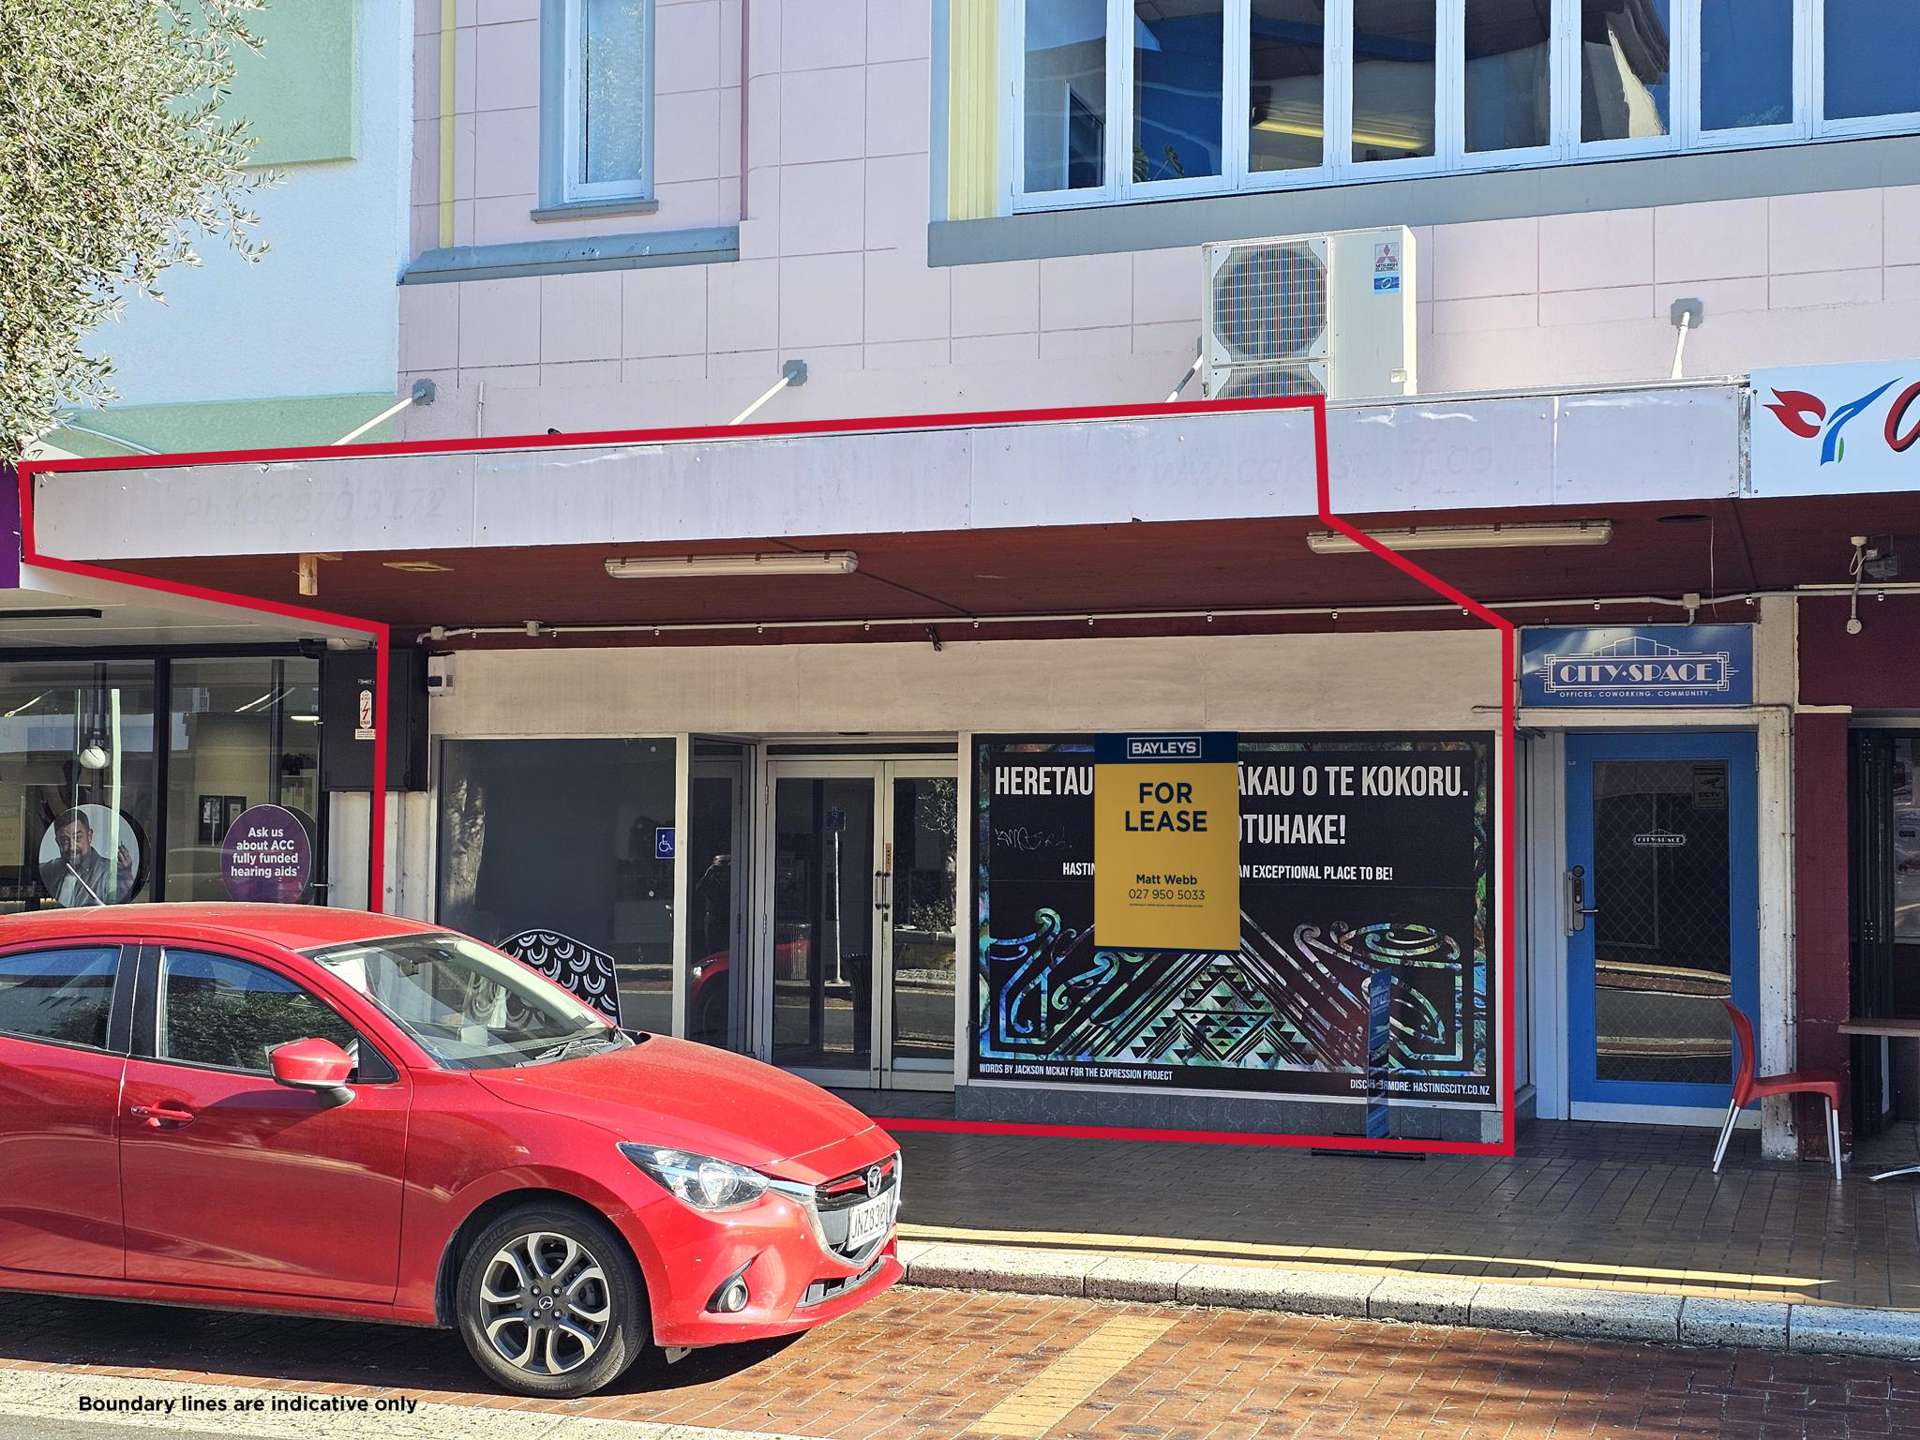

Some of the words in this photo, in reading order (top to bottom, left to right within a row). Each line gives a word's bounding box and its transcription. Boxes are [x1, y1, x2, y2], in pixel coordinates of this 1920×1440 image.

[1560, 664, 1624, 683] CITY
[1628, 663, 1713, 682] SPACE
[1132, 742, 1197, 754] BAYLEYS
[1302, 766, 1318, 796] O
[1324, 766, 1354, 796] TE
[1362, 765, 1469, 797] KOKORU.
[1139, 782, 1193, 804] FOR
[1125, 810, 1208, 832] LEASE
[248, 827, 269, 838] Ask
[271, 829, 284, 837] us
[236, 840, 268, 850] about
[271, 840, 295, 850] ACC
[232, 853, 257, 865] fully
[259, 853, 299, 863] funded
[230, 866, 272, 878] hearing
[1252, 865, 1322, 880] EXCEPTIONAL
[1324, 866, 1358, 880] PLACE
[1359, 866, 1373, 880] TO
[1375, 867, 1393, 880] BE!
[1136, 874, 1161, 885] Matt
[1164, 874, 1198, 885] Webb
[1128, 889, 1149, 899] 027
[1152, 889, 1174, 899] 950
[1177, 890, 1206, 900] 5033
[979, 1063, 1003, 1073] WORDS
[1004, 1064, 1013, 1074] BY
[1014, 1065, 1044, 1075] JACKSON
[1045, 1066, 1069, 1076] MCKAY
[1070, 1067, 1084, 1077] FOR
[1085, 1067, 1098, 1077] THE
[1099, 1068, 1141, 1079] EXPRESSION
[1143, 1070, 1173, 1080] PROJECT
[1388, 1081, 1411, 1092] MORE:
[1412, 1082, 1491, 1096] HASTINGSCITY.CO.NZ
